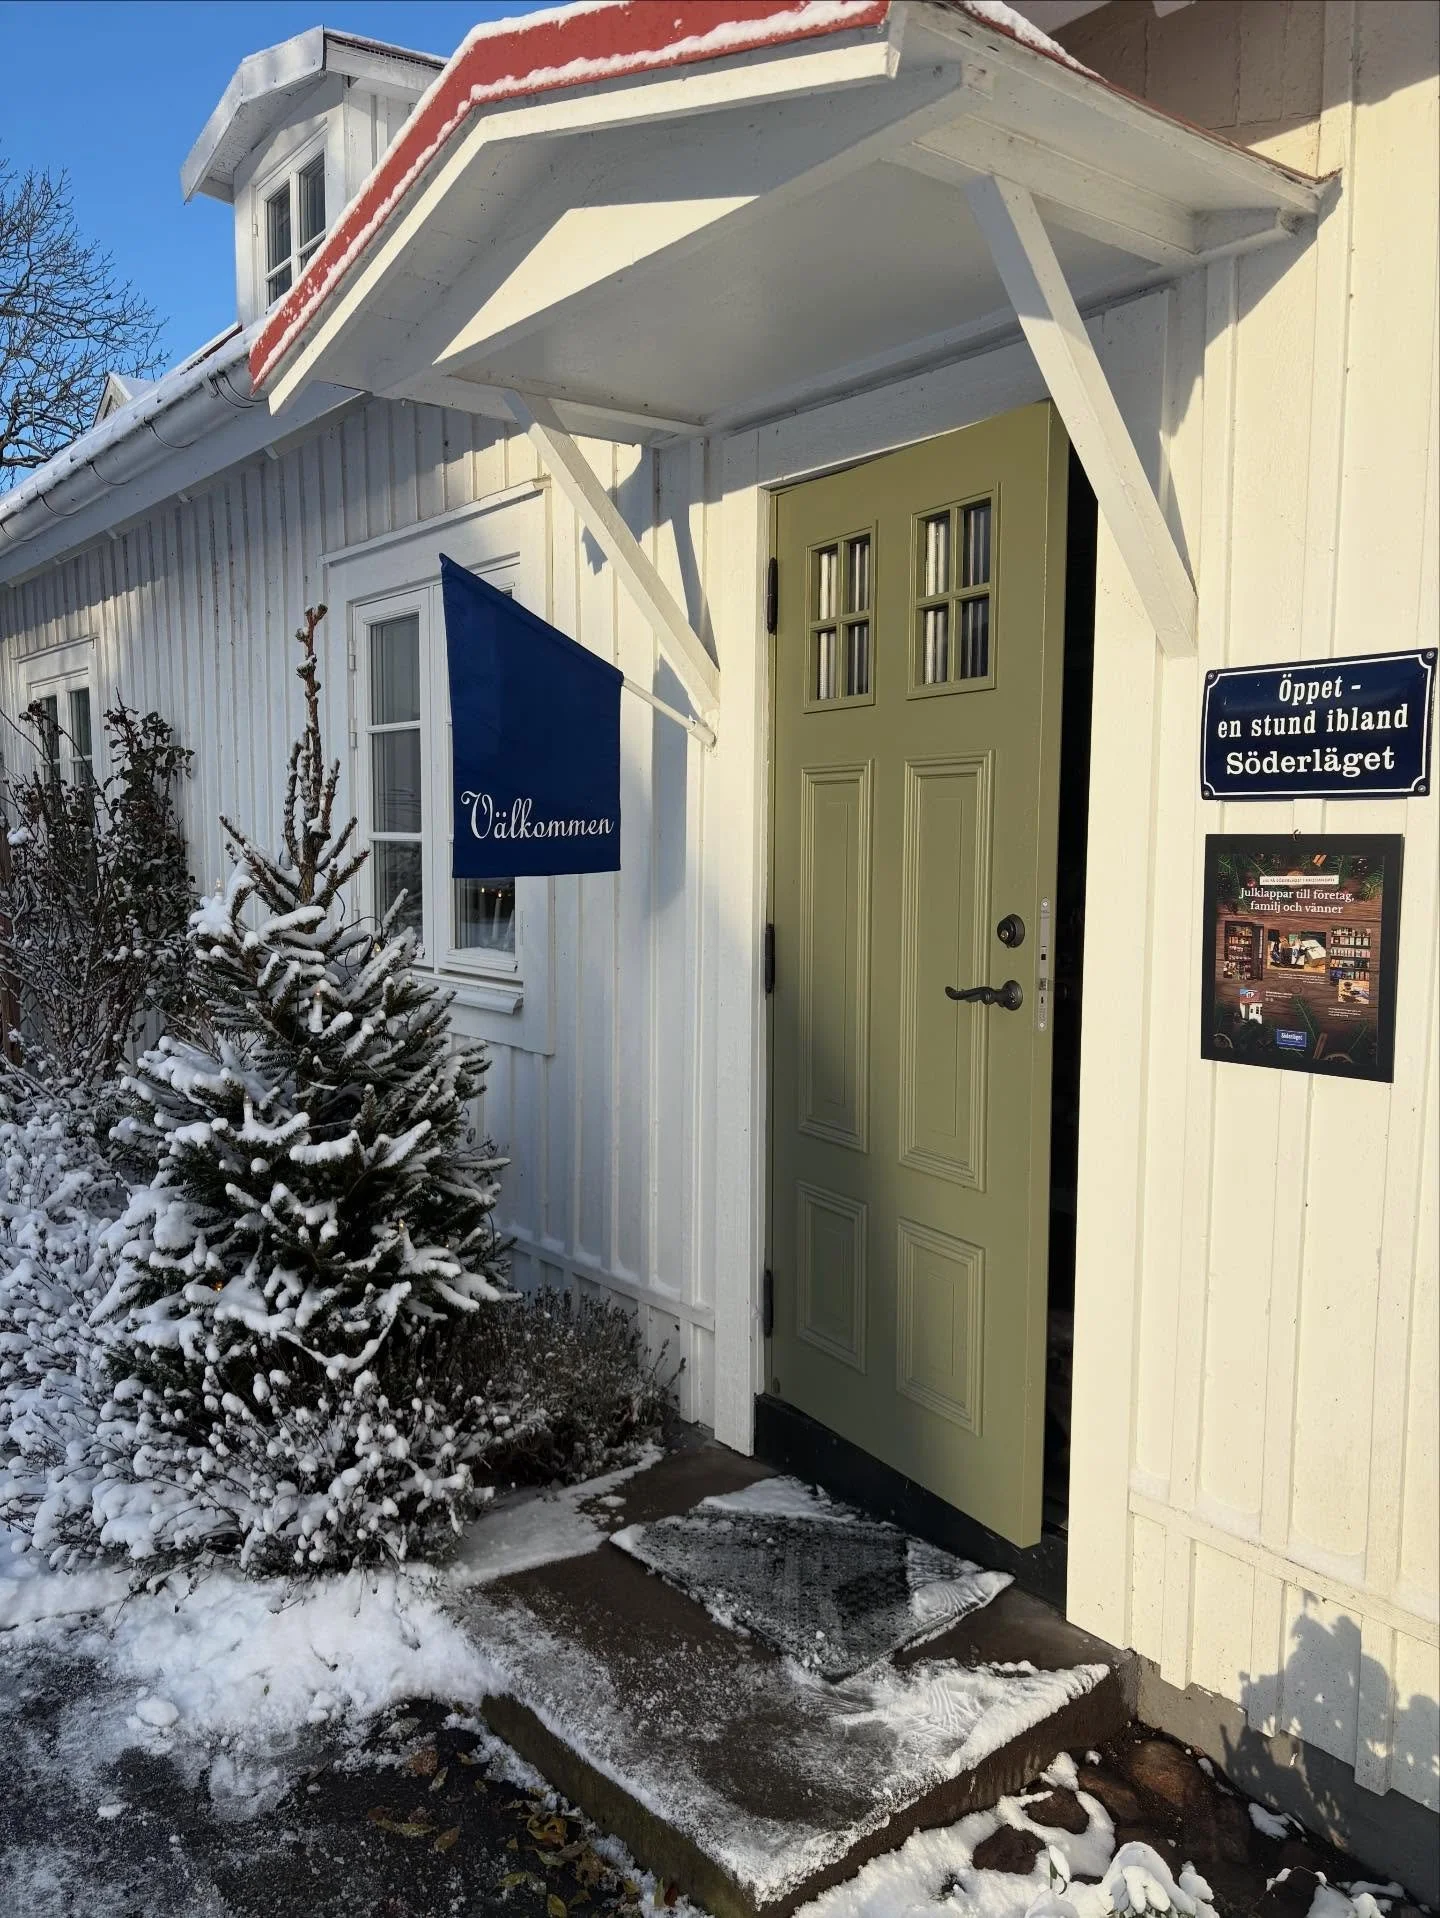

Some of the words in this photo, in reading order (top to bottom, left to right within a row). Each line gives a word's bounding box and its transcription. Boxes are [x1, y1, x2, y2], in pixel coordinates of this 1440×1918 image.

[1279, 673, 1343, 705] Öppet
[1217, 719, 1242, 738] en
[1251, 710, 1316, 737] stund
[1326, 703, 1408, 732] ibland
[1226, 745, 1395, 777] Söderläget
[461, 790, 614, 839] Välkommen
[1239, 887, 1294, 900] Julklappar
[1296, 889, 1310, 899] till
[1313, 889, 1355, 903] företag,
[1250, 901, 1281, 913] familj
[1283, 903, 1302, 912] och
[1305, 903, 1343, 914] vänner
